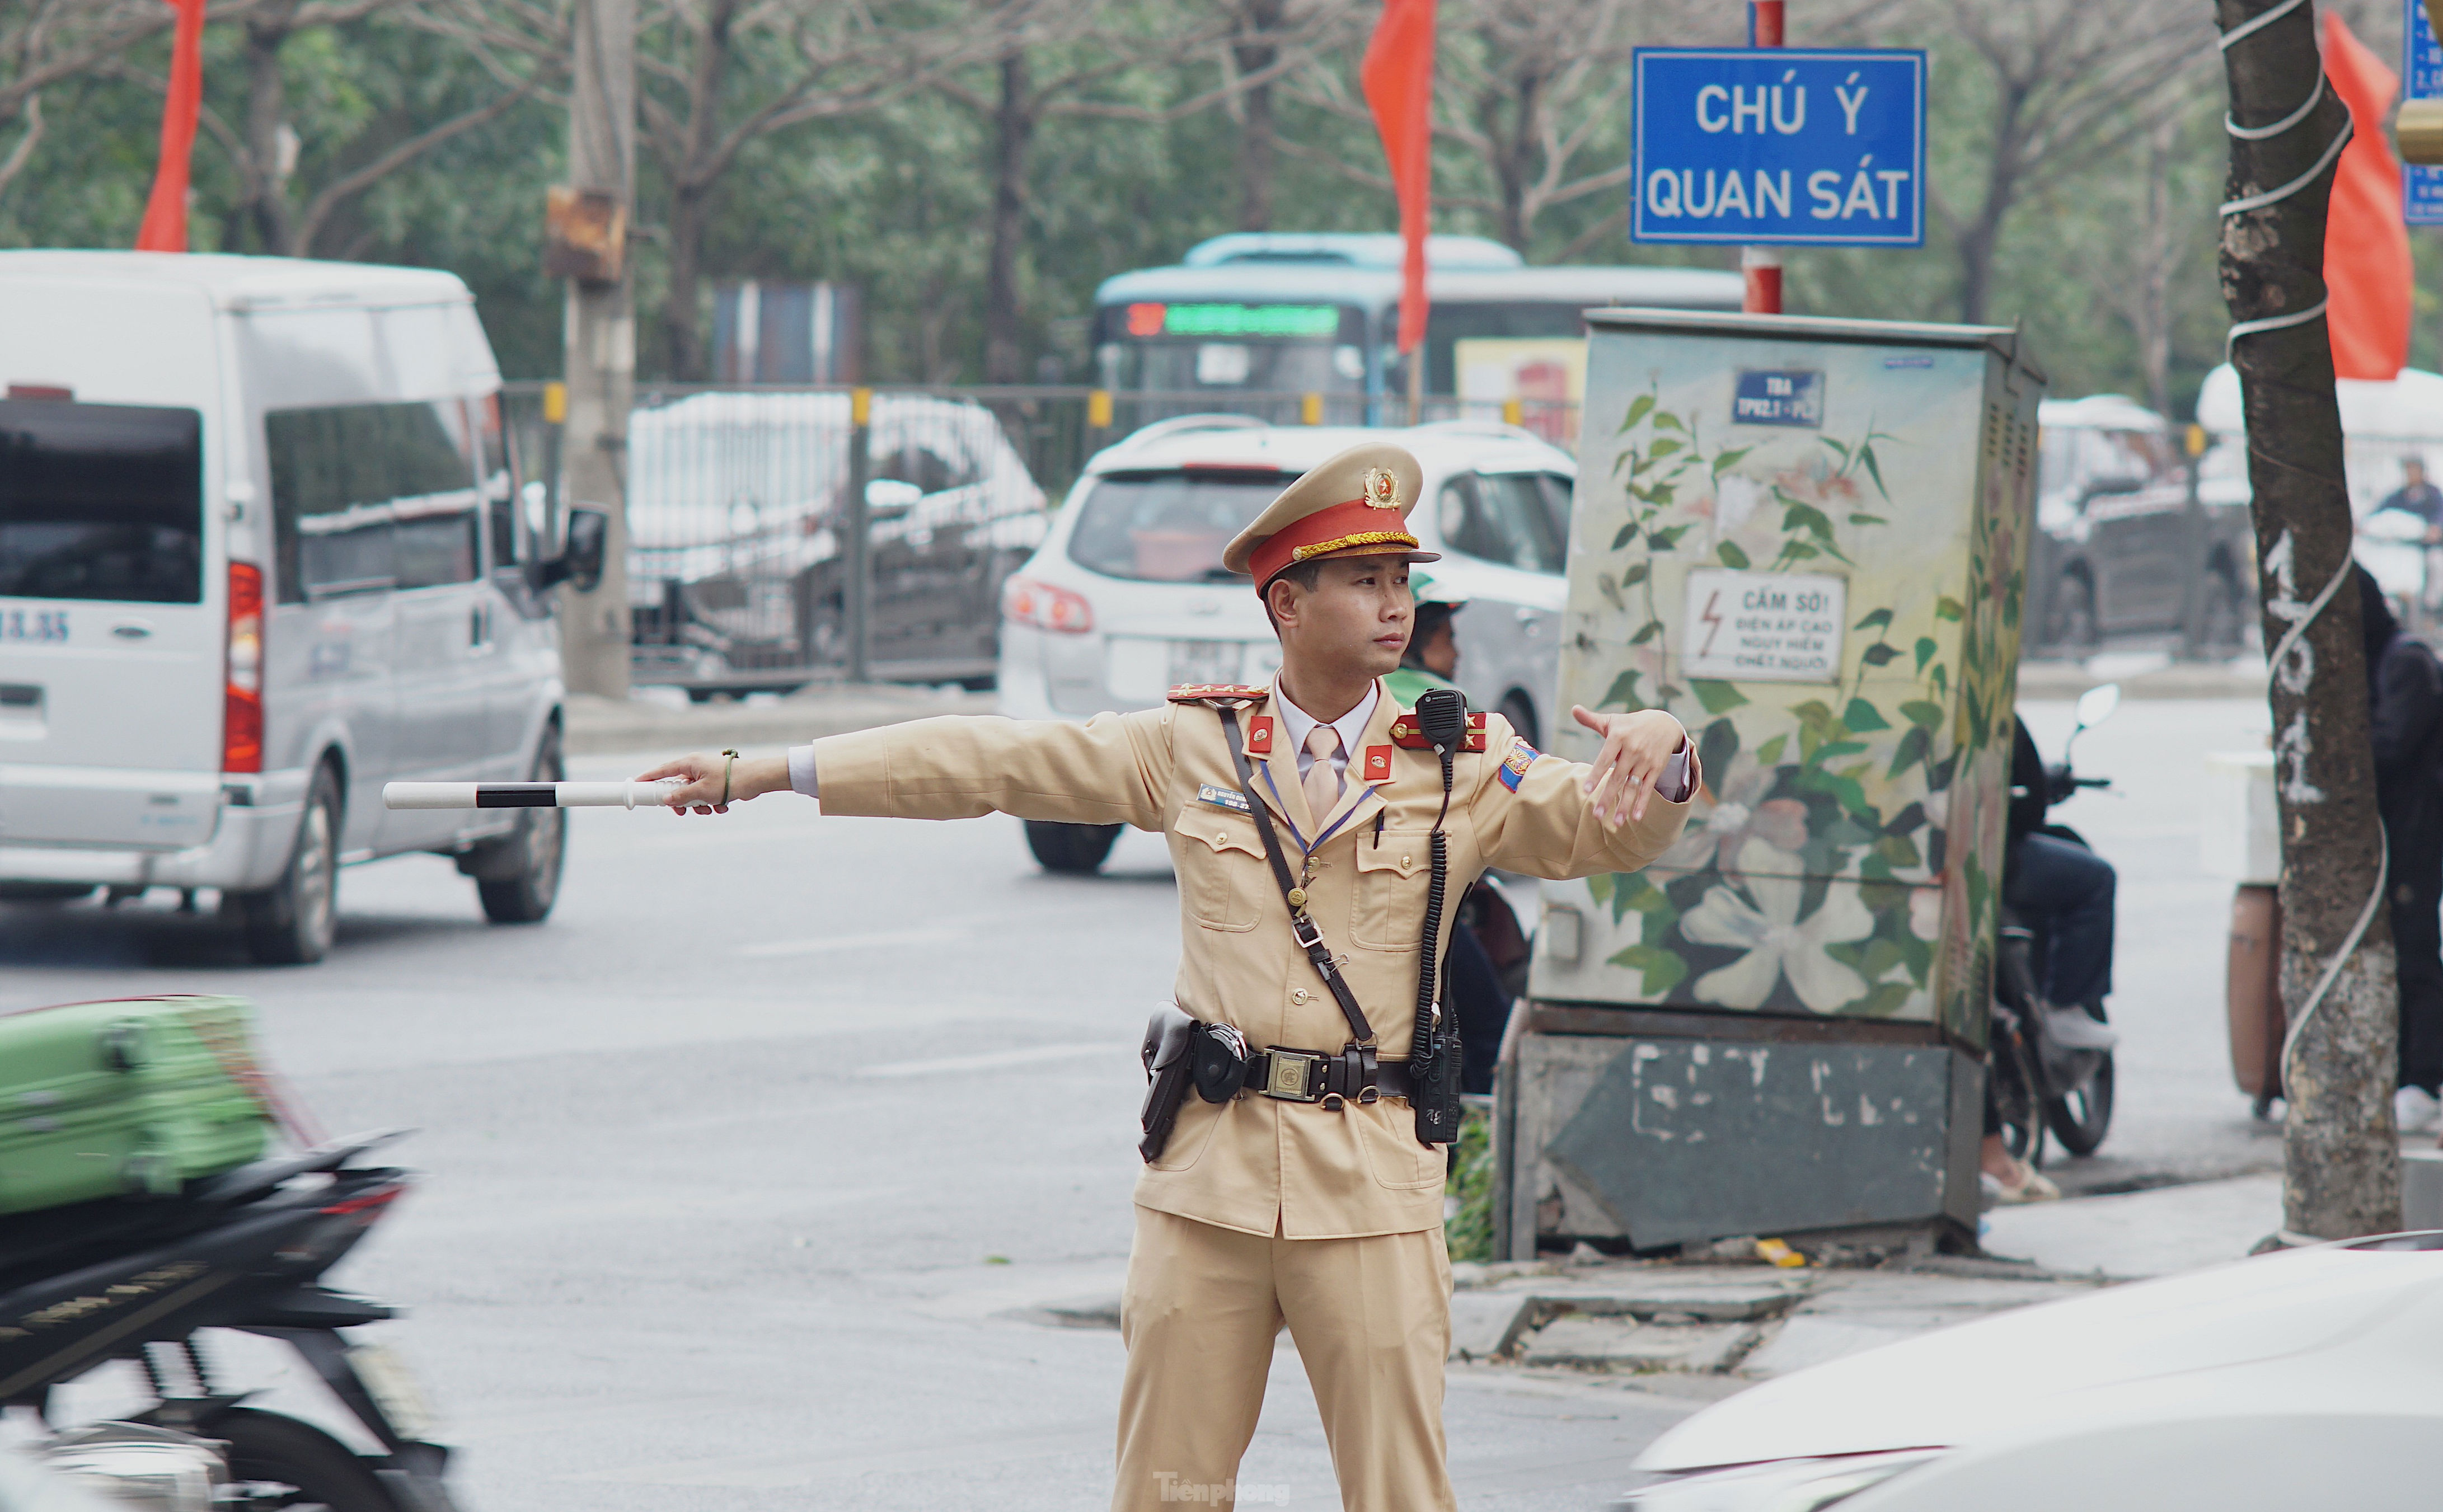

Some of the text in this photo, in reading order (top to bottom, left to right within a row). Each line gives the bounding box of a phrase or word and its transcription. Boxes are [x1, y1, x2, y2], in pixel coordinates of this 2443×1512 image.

[1696, 69, 1869, 135] CHÚ Ý
[1647, 153, 1910, 219] QUAN SÁT
[1743, 585, 1786, 611] CẤM
[1801, 621, 1833, 634] CAO
[1740, 637, 1781, 650] NGUY
